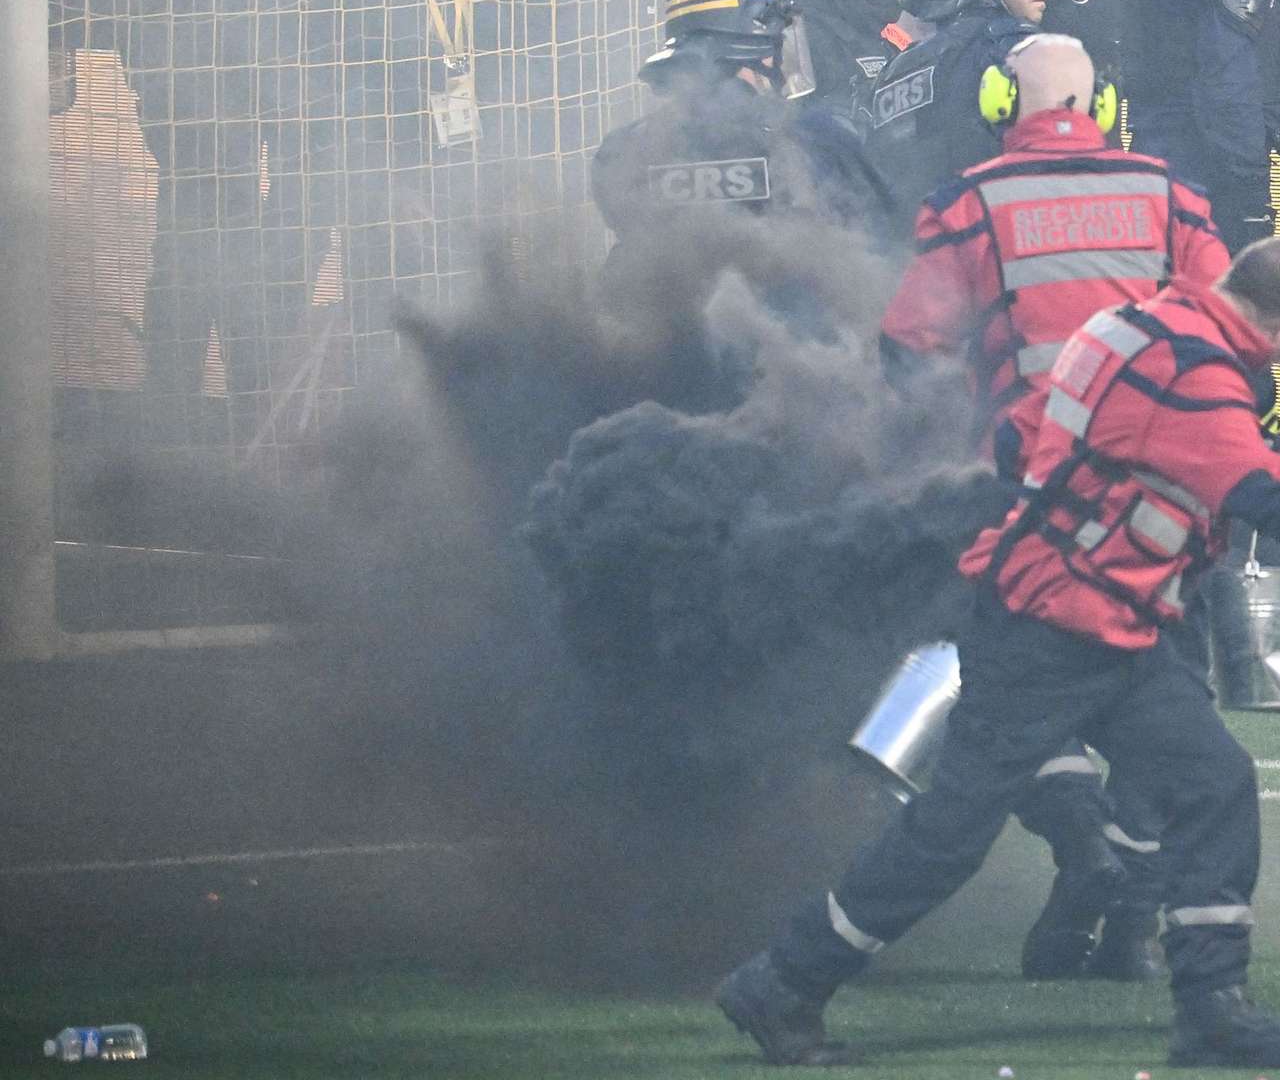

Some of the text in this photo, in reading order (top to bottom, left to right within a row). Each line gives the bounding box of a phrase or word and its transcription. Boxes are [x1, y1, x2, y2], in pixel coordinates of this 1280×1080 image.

[878, 75, 924, 119] CRS
[661, 165, 754, 198] CRS
[1015, 220, 1150, 248] INCENDIE
